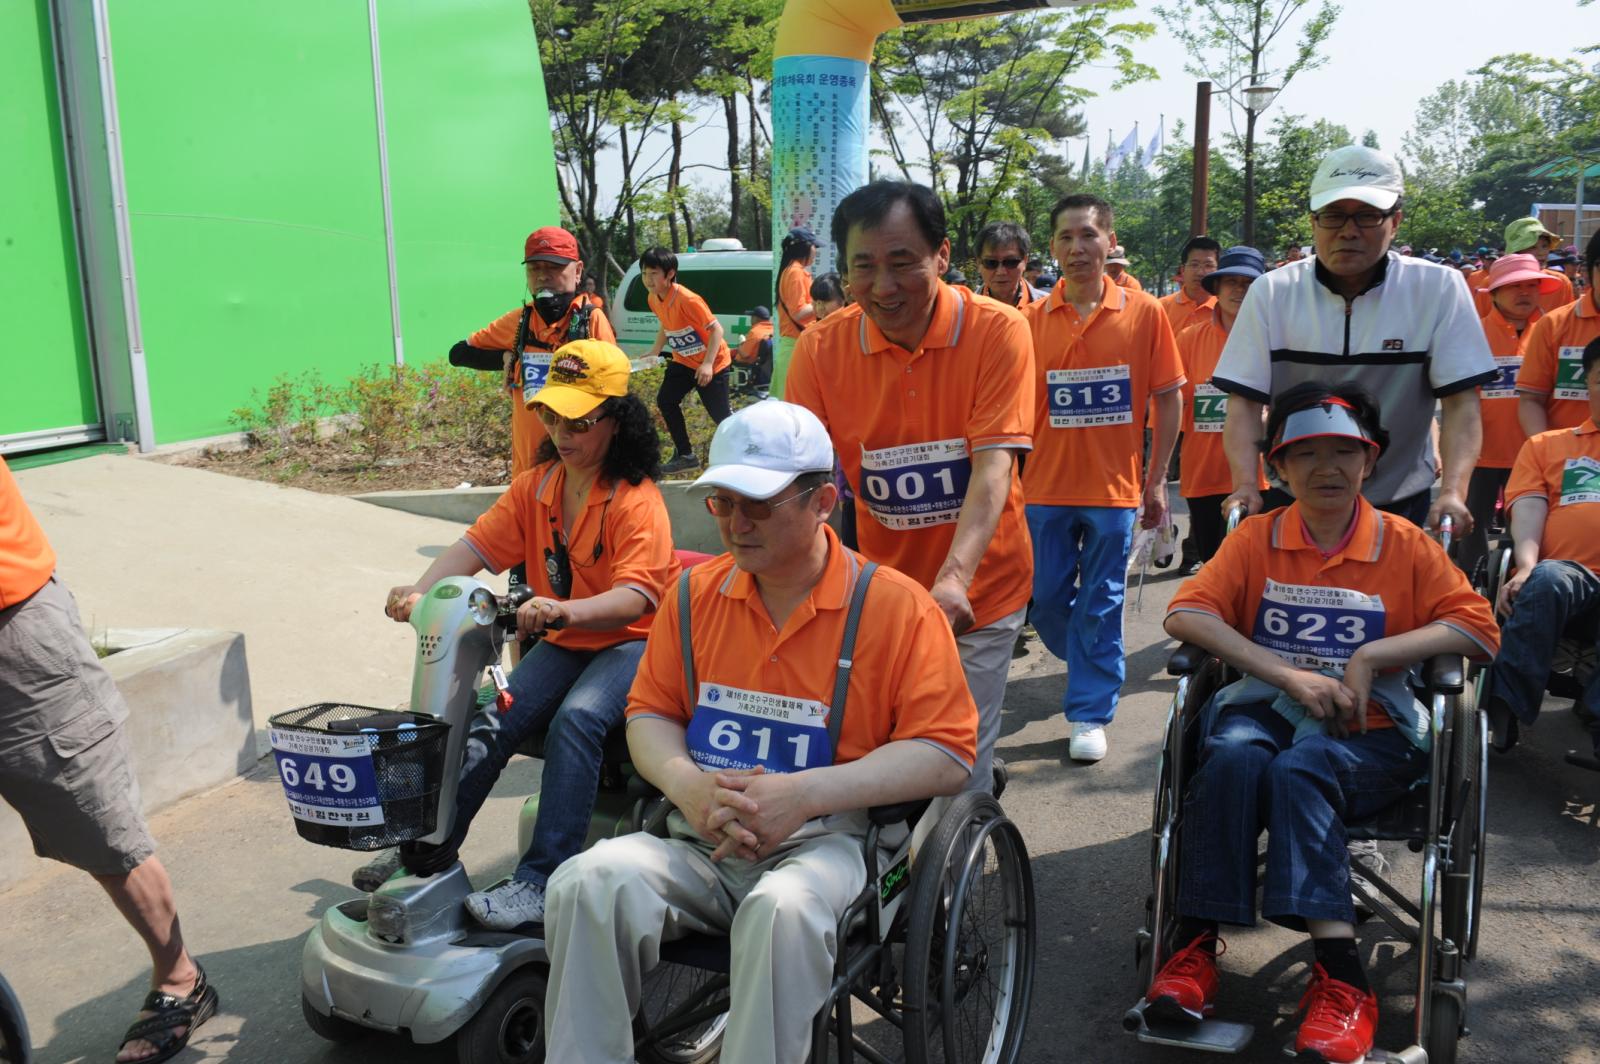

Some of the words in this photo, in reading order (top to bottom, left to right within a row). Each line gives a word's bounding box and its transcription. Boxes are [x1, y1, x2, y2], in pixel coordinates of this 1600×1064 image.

[1054, 384, 1122, 407] 613
[866, 467, 955, 501] 001
[1263, 608, 1366, 644] 623
[708, 719, 811, 768] 611
[280, 758, 357, 793] 649
